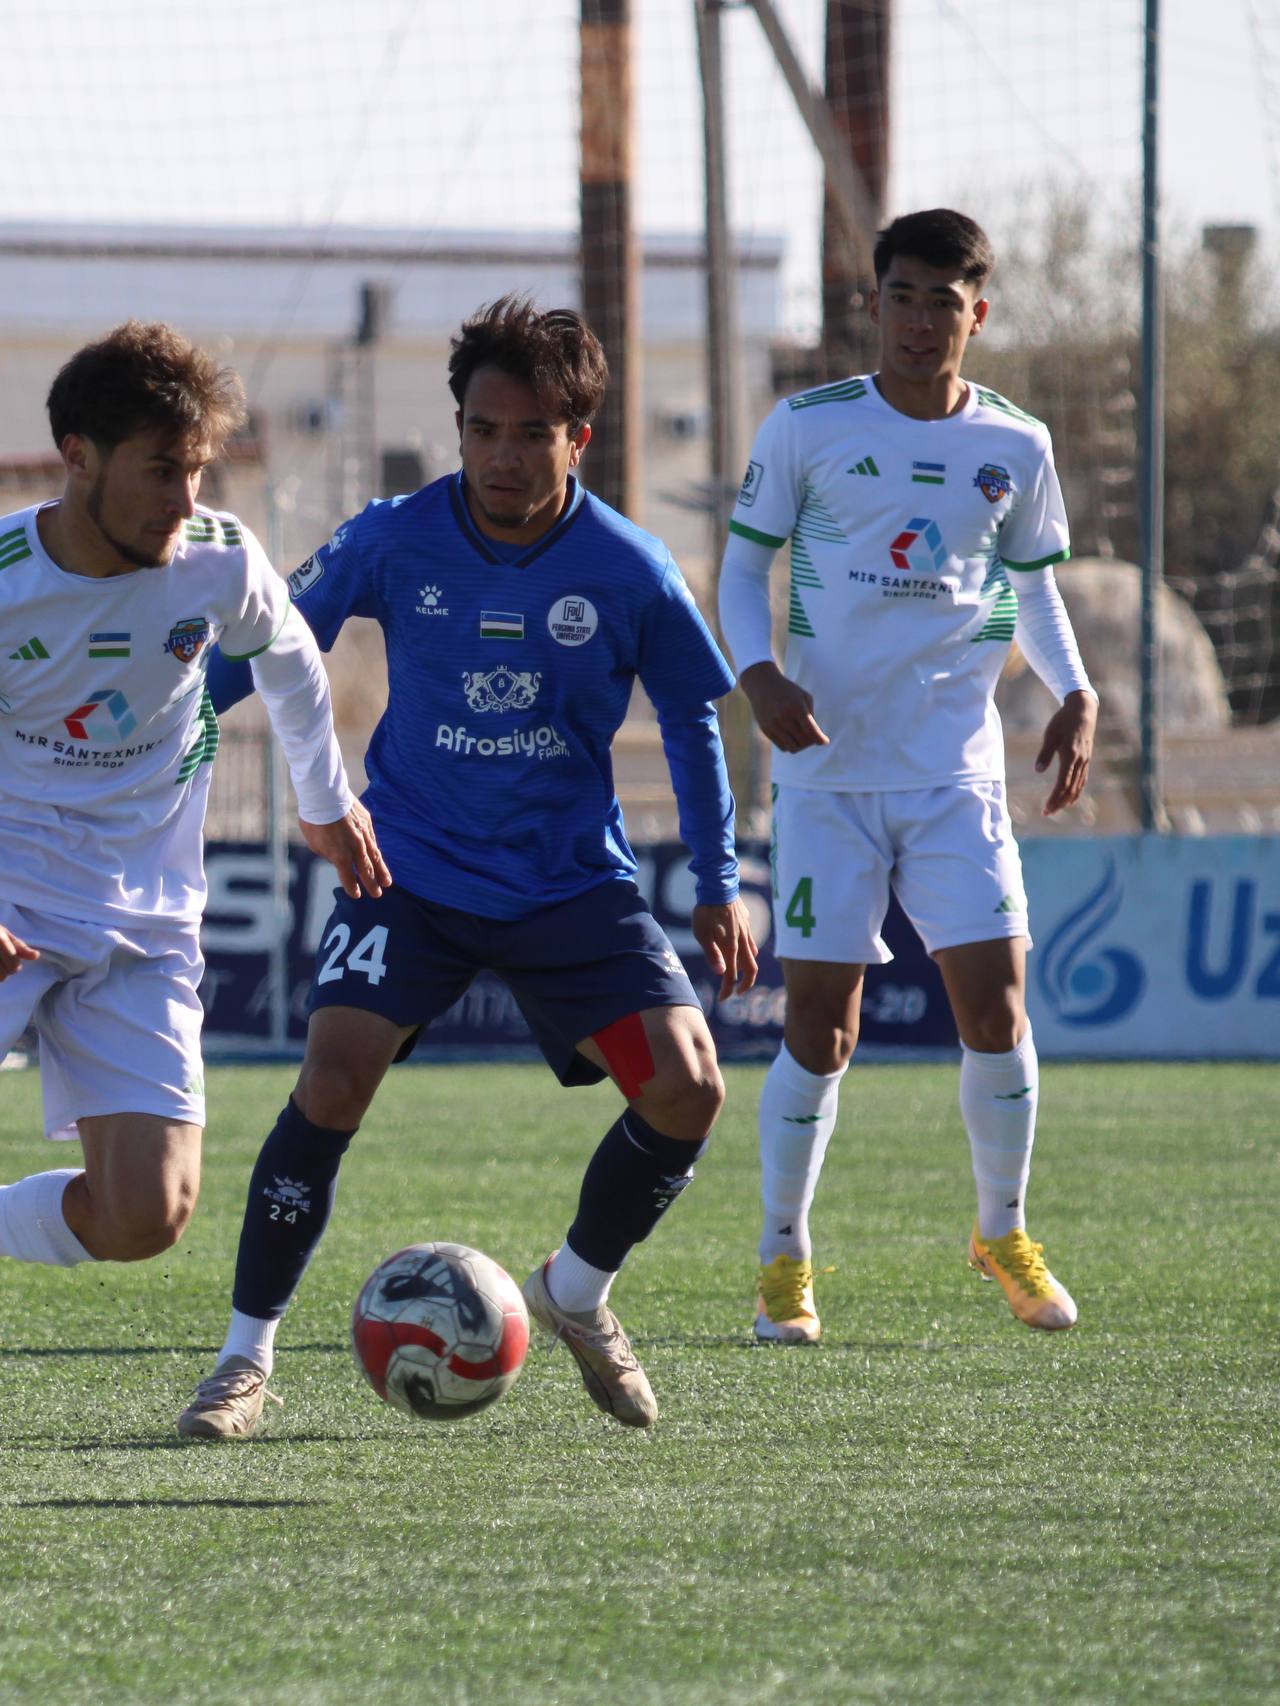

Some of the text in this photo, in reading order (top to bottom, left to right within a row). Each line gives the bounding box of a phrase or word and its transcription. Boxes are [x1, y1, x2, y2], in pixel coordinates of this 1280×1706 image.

[849, 570, 961, 594] MIR SANTEXNI
[415, 605, 449, 616] KELME
[16, 730, 163, 760] MIR SANTEXNIK
[53, 757, 90, 767] SINCE
[785, 876, 816, 938] 4
[318, 922, 389, 986] 24
[1006, 1198, 1019, 1209] 4
[269, 1204, 297, 1224] 24
[778, 1224, 792, 1237] 4
